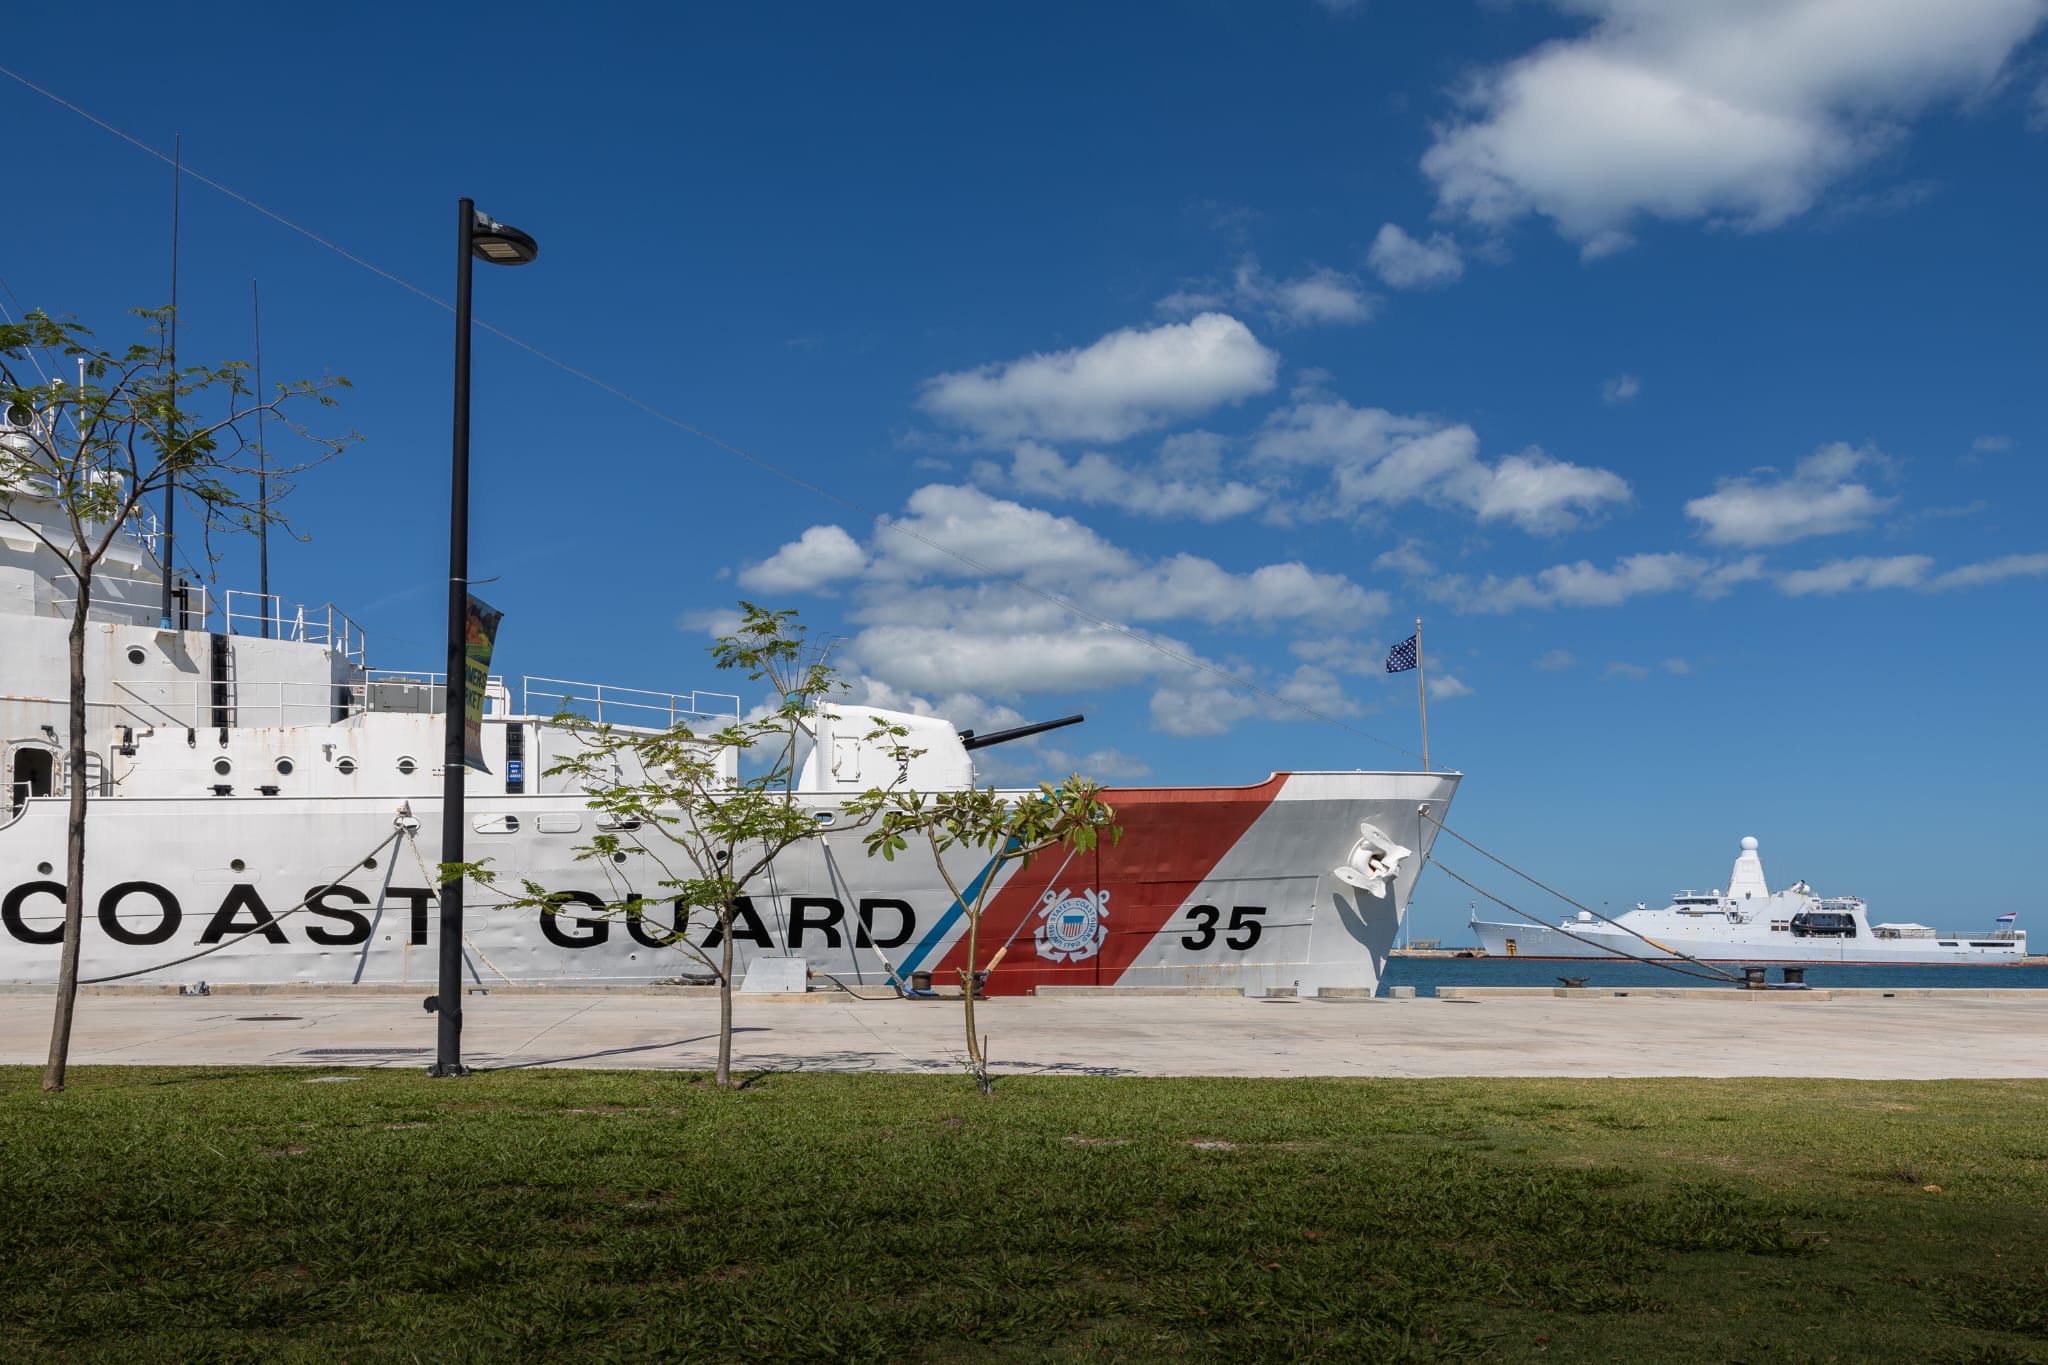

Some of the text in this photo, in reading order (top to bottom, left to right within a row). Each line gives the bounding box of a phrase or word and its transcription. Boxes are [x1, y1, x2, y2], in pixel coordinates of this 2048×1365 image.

[1, 880, 917, 949] COAST GUARD
[1050, 901, 1072, 921] STATES
[1075, 900, 1095, 917] COAST
[1081, 917, 1097, 942] GUARD
[1181, 904, 1267, 951] 35
